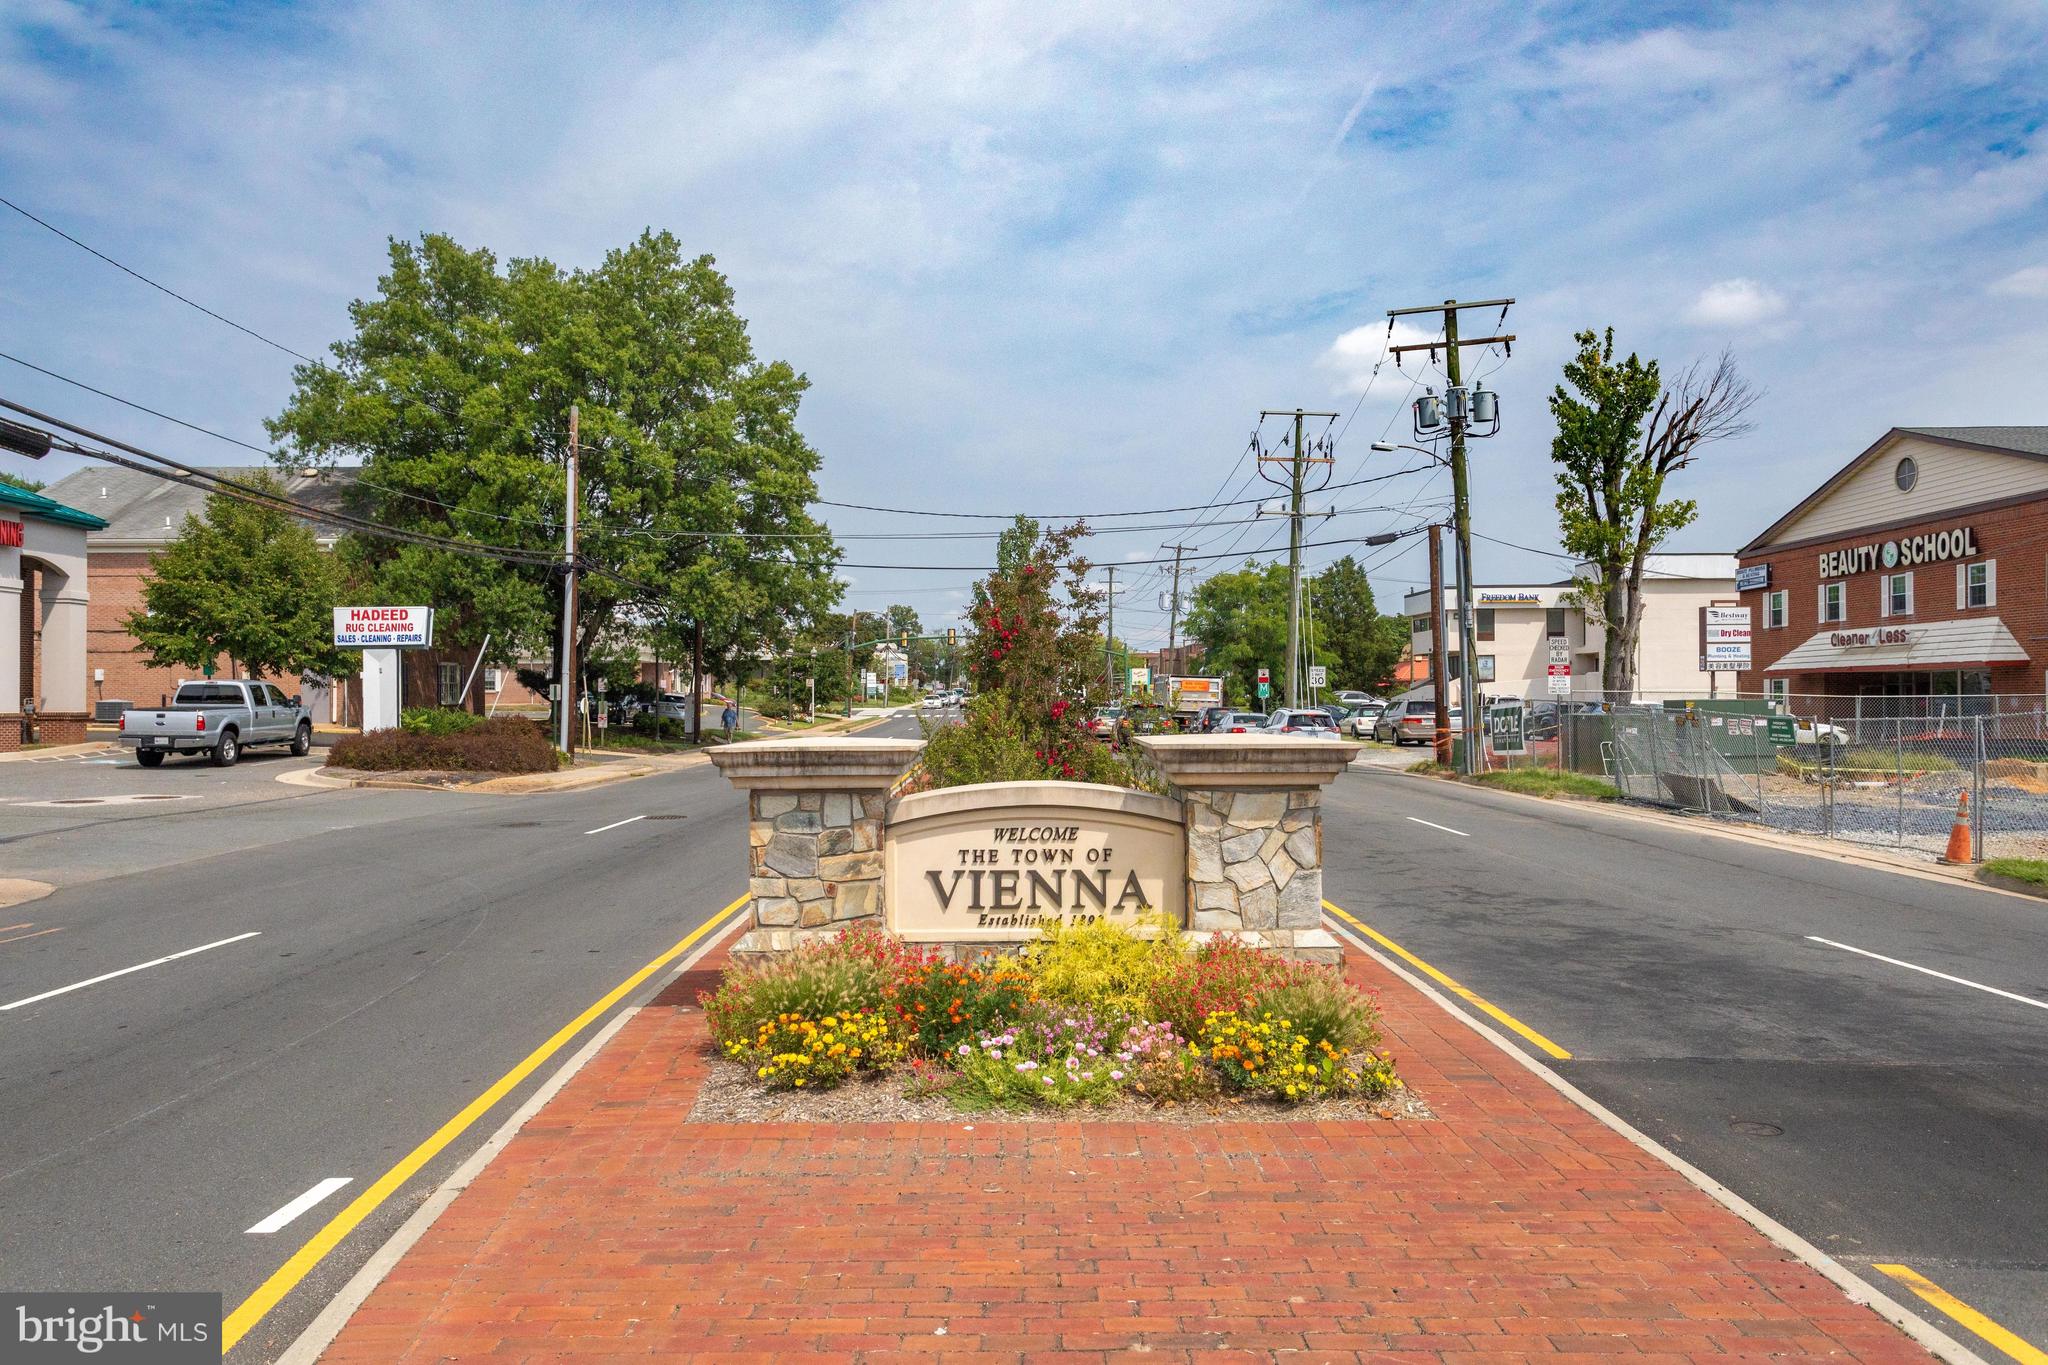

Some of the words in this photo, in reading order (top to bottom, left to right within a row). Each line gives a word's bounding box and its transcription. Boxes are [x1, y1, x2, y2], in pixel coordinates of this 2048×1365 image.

[1819, 543, 1880, 578] BEAUTY
[1900, 527, 1977, 566] SCHOOL
[351, 609, 409, 621] HADEED
[1720, 611, 1748, 620] Bestway
[345, 623, 365, 633] RUG
[367, 623, 414, 632] CLEANING
[1720, 629, 1732, 638] Dry
[1732, 629, 1752, 637] Clean
[336, 635, 356, 643] SALES
[360, 634, 392, 643] CLEANING
[396, 634, 422, 642] REPAIRS
[1831, 632, 1870, 647] Cleaner
[1879, 628, 1908, 644] Less
[1311, 677, 1324, 685] 30
[993, 827, 1079, 842] WELCOME
[958, 850, 999, 864] THE
[1012, 849, 1074, 864] TOWN
[1087, 848, 1113, 863] OF
[924, 869, 1152, 911] VIENNA
